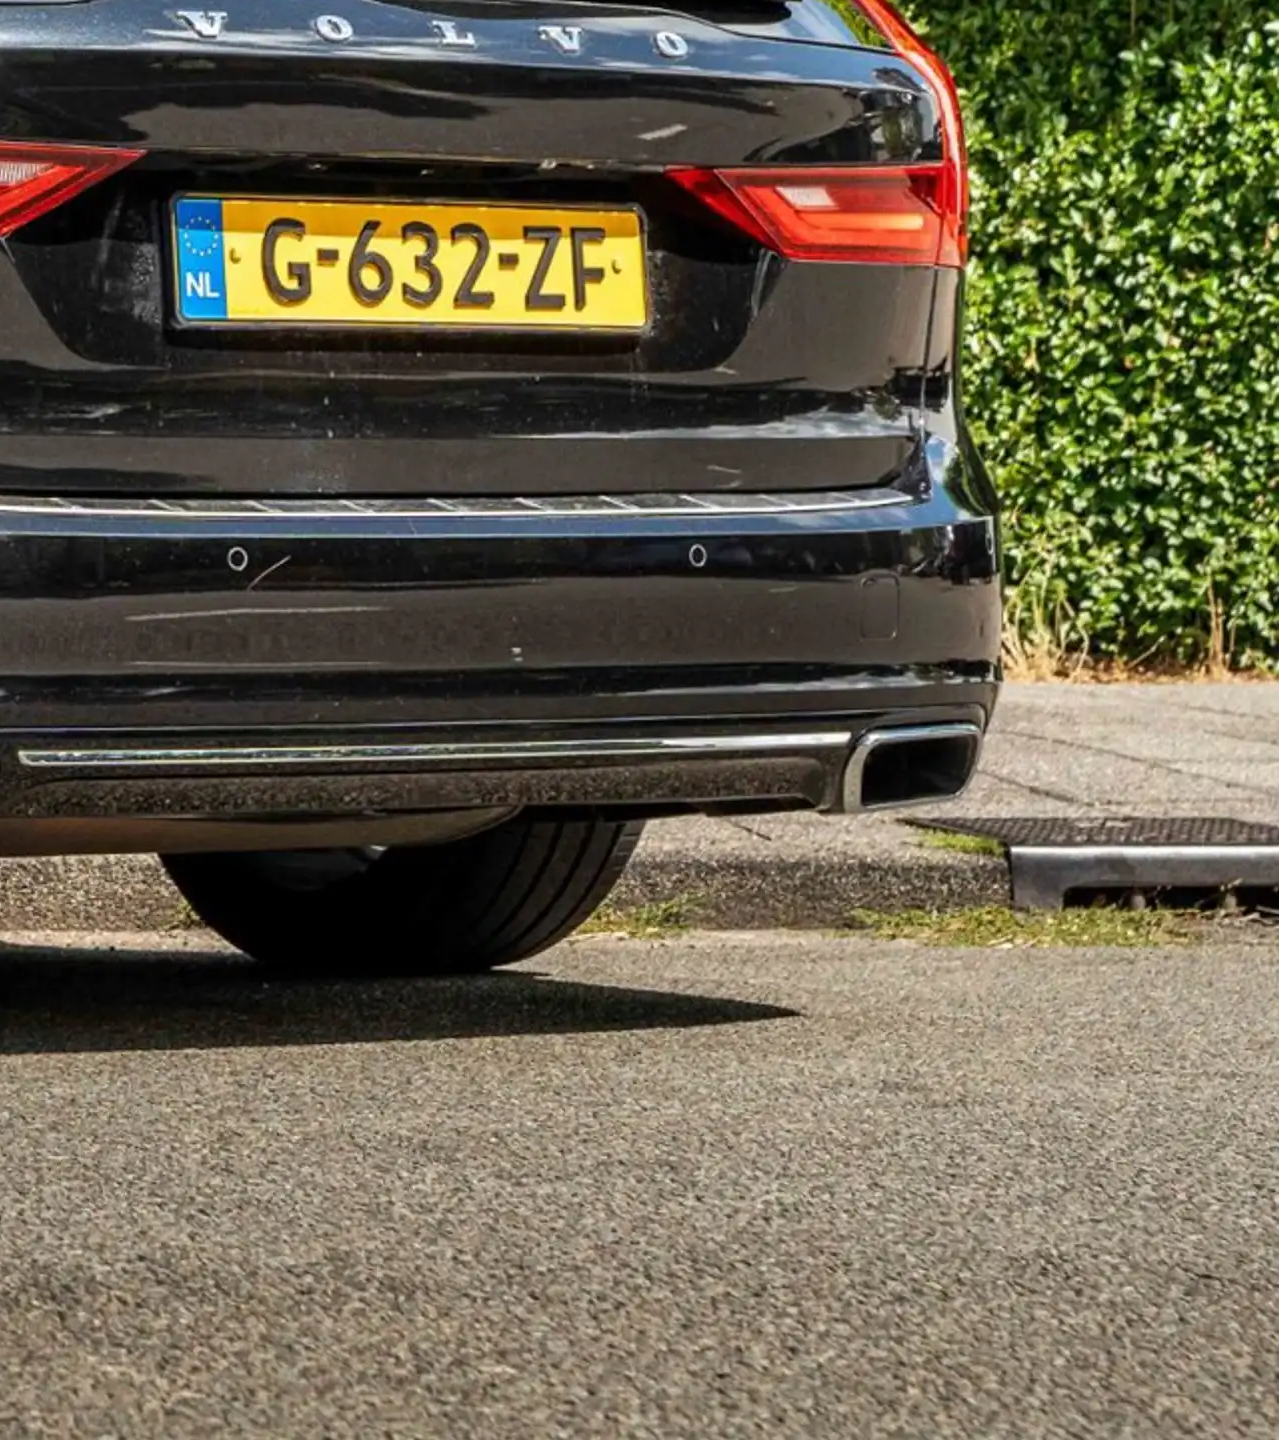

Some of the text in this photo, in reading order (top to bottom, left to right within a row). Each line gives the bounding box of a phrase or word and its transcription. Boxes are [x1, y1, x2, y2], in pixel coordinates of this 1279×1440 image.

[176, 9, 689, 58] VOLVO
[186, 271, 220, 298] NL
[261, 217, 606, 311] G-632-ZF
